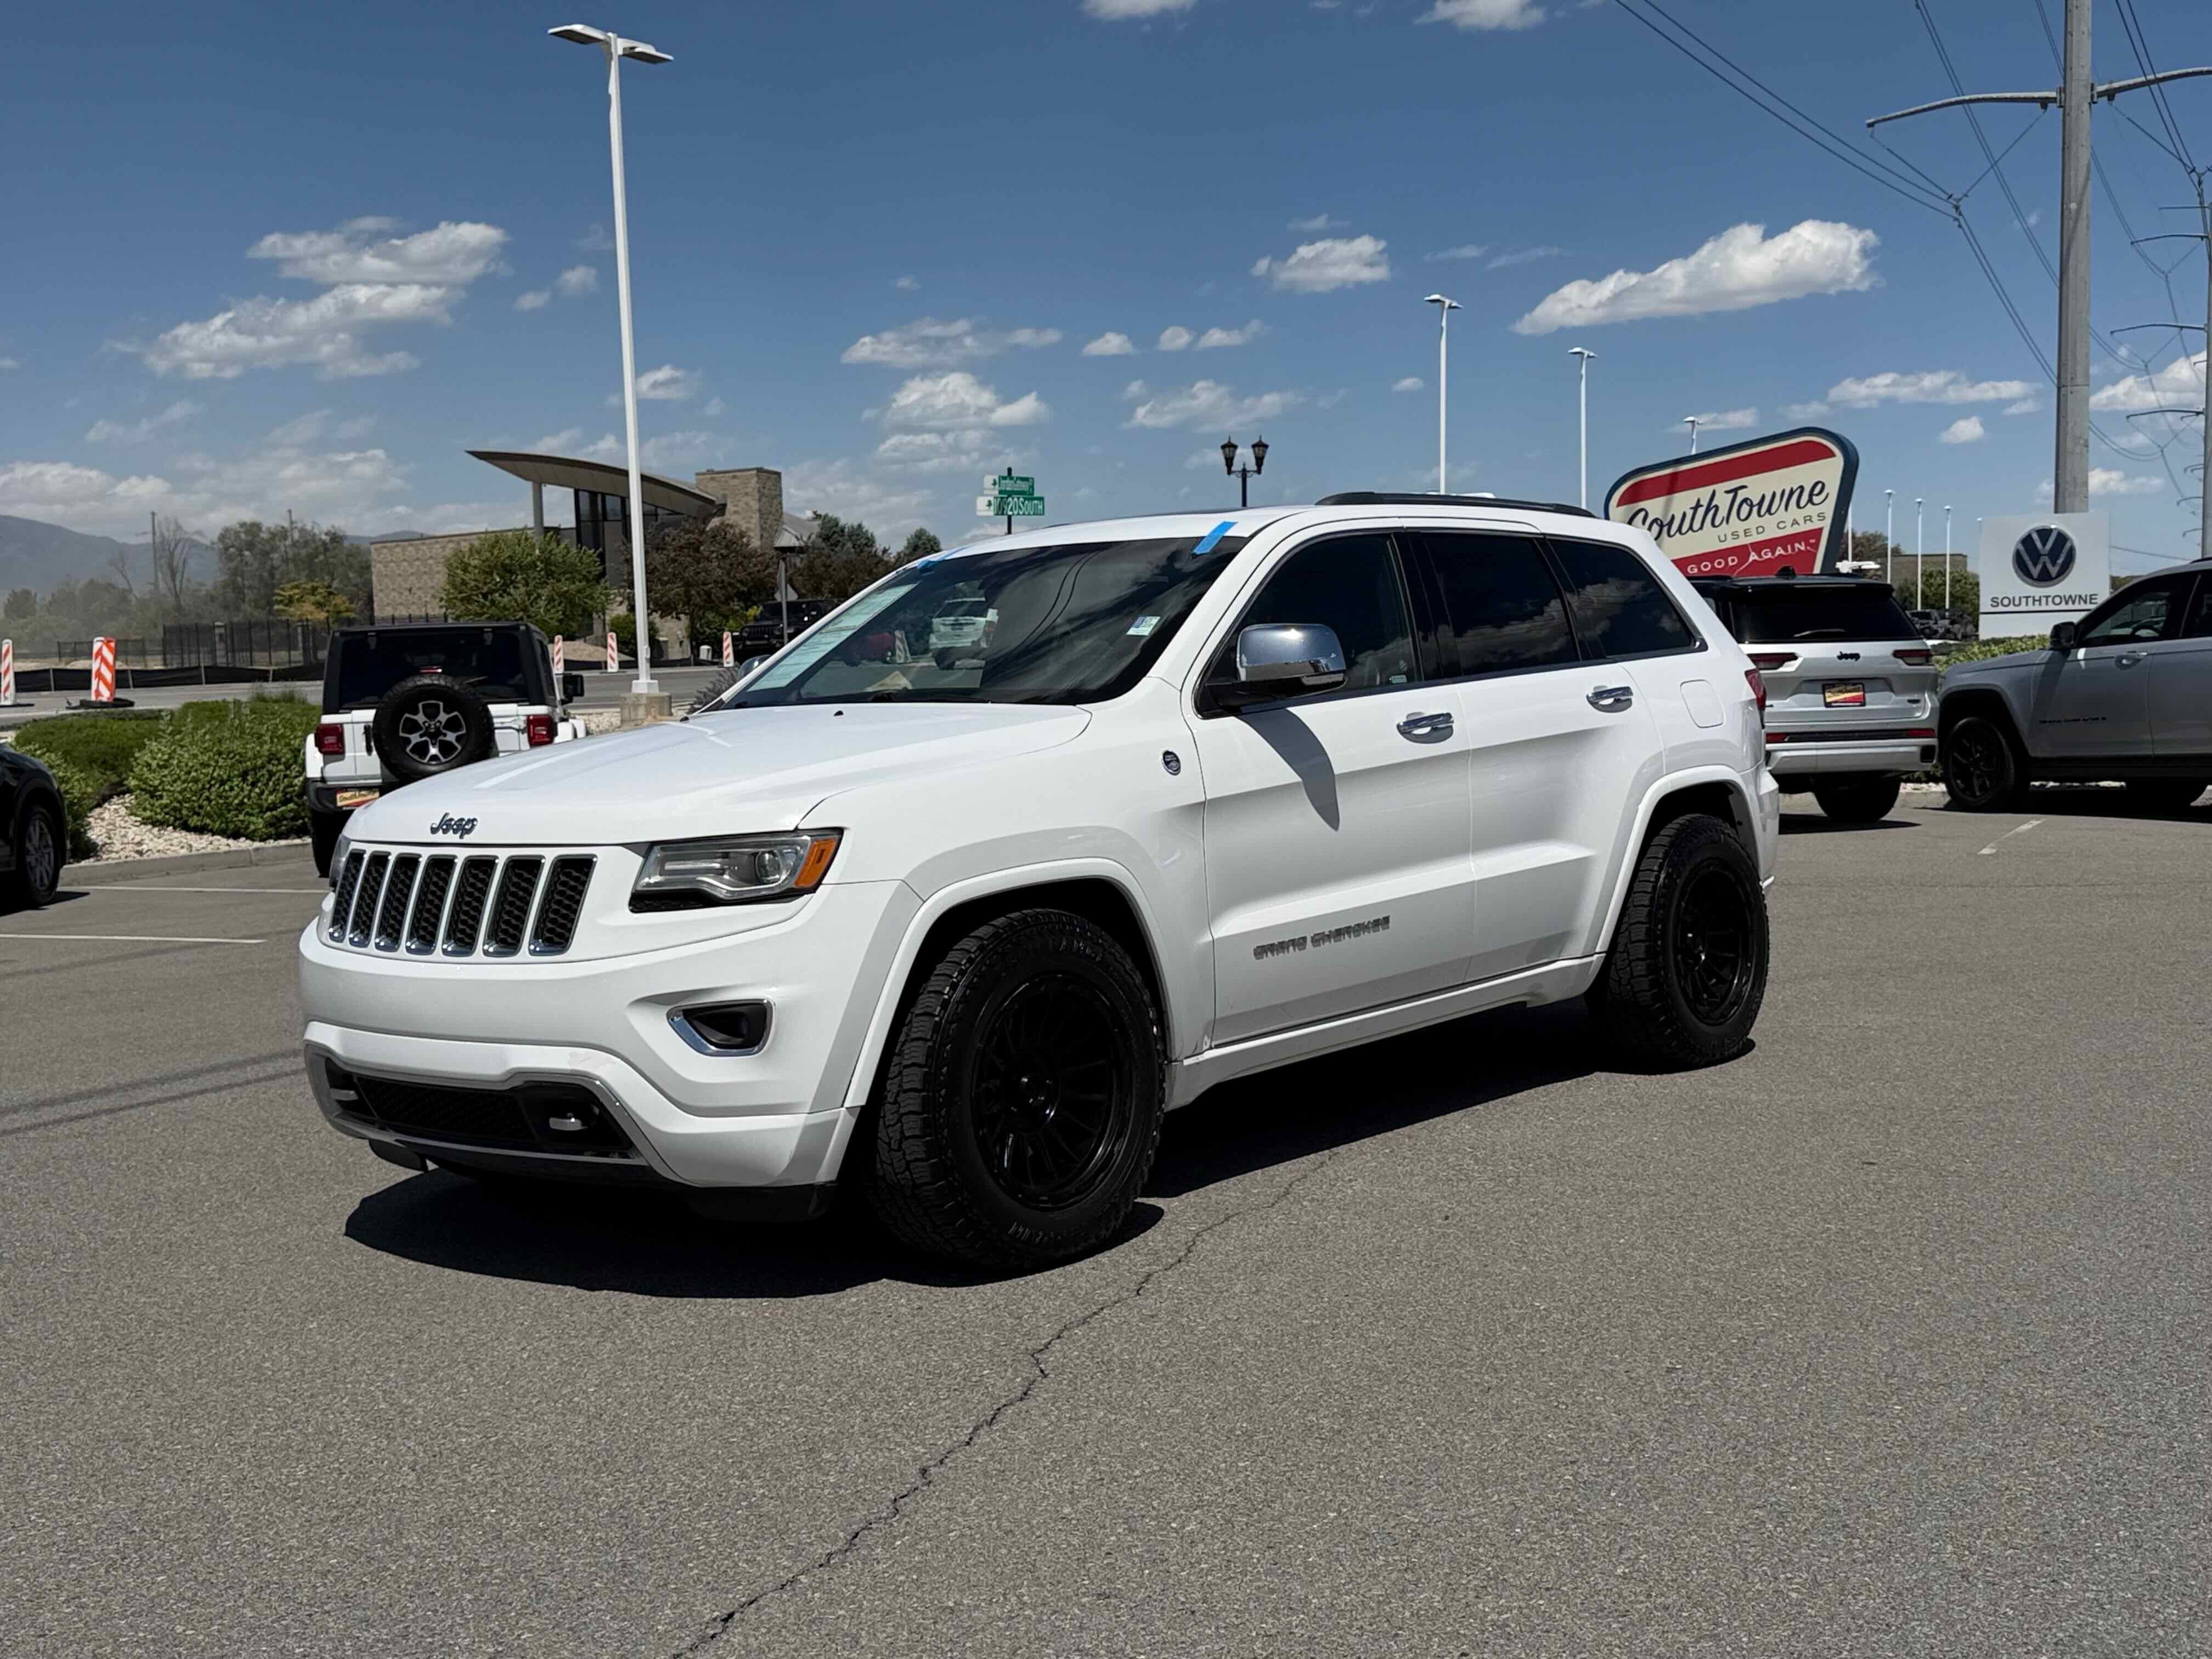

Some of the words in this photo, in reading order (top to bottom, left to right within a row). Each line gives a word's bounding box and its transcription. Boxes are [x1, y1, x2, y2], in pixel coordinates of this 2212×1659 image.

[1718, 525, 1765, 543] USED
[1776, 512, 1826, 530] CARS
[1687, 556, 1738, 574] GOOD
[1990, 594, 2098, 607] SOUTHTOWNE
[430, 812, 478, 839] Jeep
